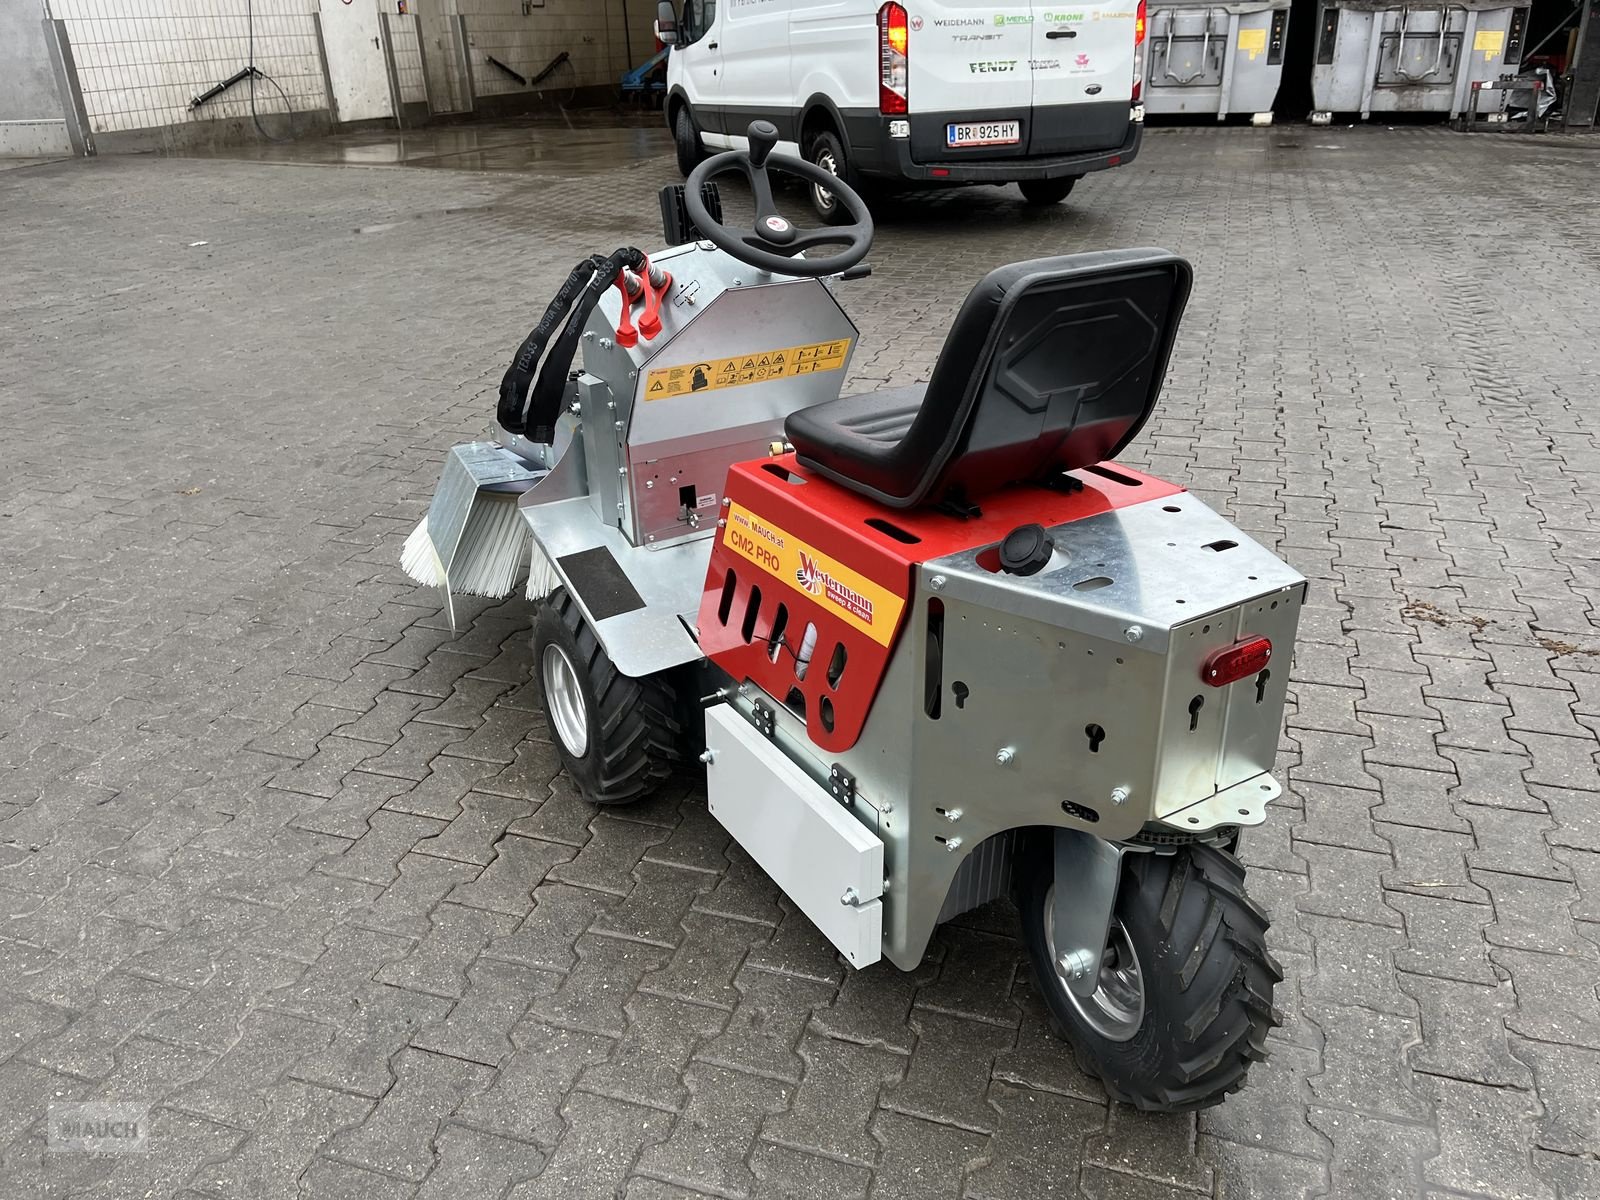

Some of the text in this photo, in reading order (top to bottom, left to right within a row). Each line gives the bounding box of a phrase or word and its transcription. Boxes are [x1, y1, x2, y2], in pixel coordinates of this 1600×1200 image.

[934, 18, 985, 27] WEIDEMANN
[1006, 15, 1034, 24] MERLO
[1054, 13, 1085, 22] KRONE
[952, 33, 1004, 42] TRANSIT
[969, 60, 1018, 73] FENDT
[957, 124, 1015, 140] BR 925 HY
[731, 530, 780, 571] CM2 PRO
[799, 551, 873, 613] Westermann
